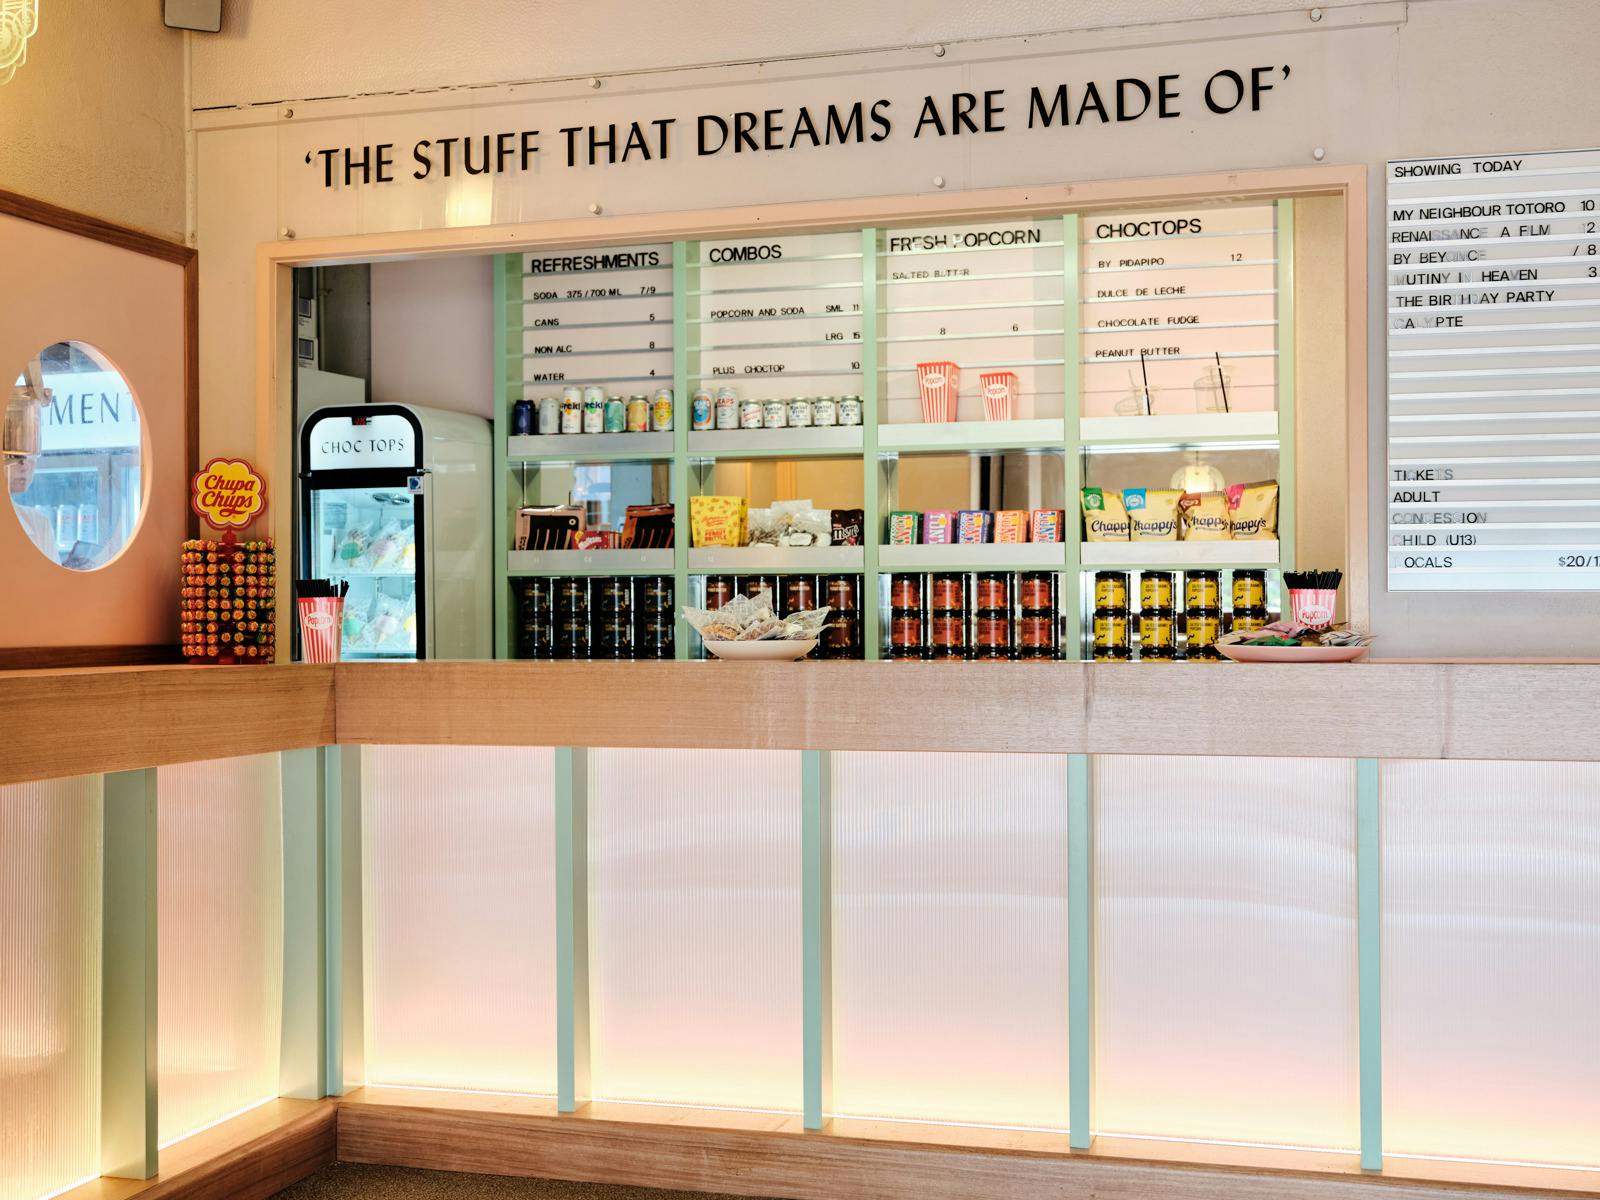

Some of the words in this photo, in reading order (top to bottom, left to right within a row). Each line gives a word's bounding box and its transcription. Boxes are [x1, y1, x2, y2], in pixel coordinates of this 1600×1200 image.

[413, 130, 540, 181] STUFF
[559, 118, 676, 168] THAT
[697, 100, 892, 157] DREAMS
[914, 90, 1006, 139] ARE
[1028, 74, 1181, 129] MADE
[1394, 163, 1461, 178] SHOWING
[1473, 160, 1523, 173] TODAY
[1393, 210, 1414, 221] MY
[1419, 205, 1502, 219] NEIGHBOUR
[1506, 201, 1566, 215] TOTORO
[1580, 199, 1595, 211] 10
[1096, 218, 1202, 239] CHOCTOPS
[1500, 226, 1511, 237] A
[890, 235, 947, 252] FRESH
[952, 229, 1041, 249] POPCORN
[709, 244, 782, 263] COMBOS
[1098, 260, 1111, 268] BY
[1119, 257, 1165, 267] PIDAPIPO
[1230, 253, 1242, 262] 12
[1393, 253, 1412, 265] BY
[531, 252, 660, 273] REFRESHMENTS
[1481, 269, 1538, 282] HEAVEN
[1588, 266, 1598, 278] 3
[533, 291, 558, 300] SODA
[566, 290, 583, 298] 375
[590, 289, 607, 297] 700
[608, 288, 622, 296] ML
[640, 286, 656, 295] 7/9
[1097, 289, 1129, 298] DULCE
[1136, 288, 1149, 296] DE
[1154, 286, 1186, 295] LECHE
[1396, 295, 1423, 307] THE
[1429, 292, 1499, 307] BIRHDAY
[1506, 290, 1555, 303] PARTY
[710, 309, 754, 319] POPCORN
[758, 308, 776, 316] AND
[781, 306, 805, 316] SODA
[825, 305, 844, 313] SML
[534, 318, 560, 327] CANS
[649, 313, 655, 321] 5
[1097, 317, 1160, 328] CHOCOLATE
[1168, 315, 1200, 325] FUDGE
[825, 332, 844, 341] LRG
[853, 332, 861, 340] 15
[939, 327, 946, 336] 8
[1012, 323, 1019, 332] 6
[534, 346, 553, 354] NON
[556, 345, 573, 353] ALC
[1095, 348, 1135, 358] PEANUT
[1141, 347, 1180, 356] BUTTER
[712, 366, 736, 375] PLUS
[744, 364, 785, 374] CHOCTOP
[851, 361, 860, 370] 10
[533, 373, 565, 382] WATER
[649, 369, 656, 377] 4
[321, 439, 362, 454] CHOC
[370, 438, 405, 453] TOPS
[204, 474, 256, 494] Chupa
[201, 491, 254, 516] Chups
[1393, 491, 1441, 503] ADULT
[1445, 534, 1477, 546] (U13)
[1394, 556, 1453, 569] OCALS
[1558, 555, 1600, 567] $20/1
[1301, 610, 1329, 622] Popcorn
